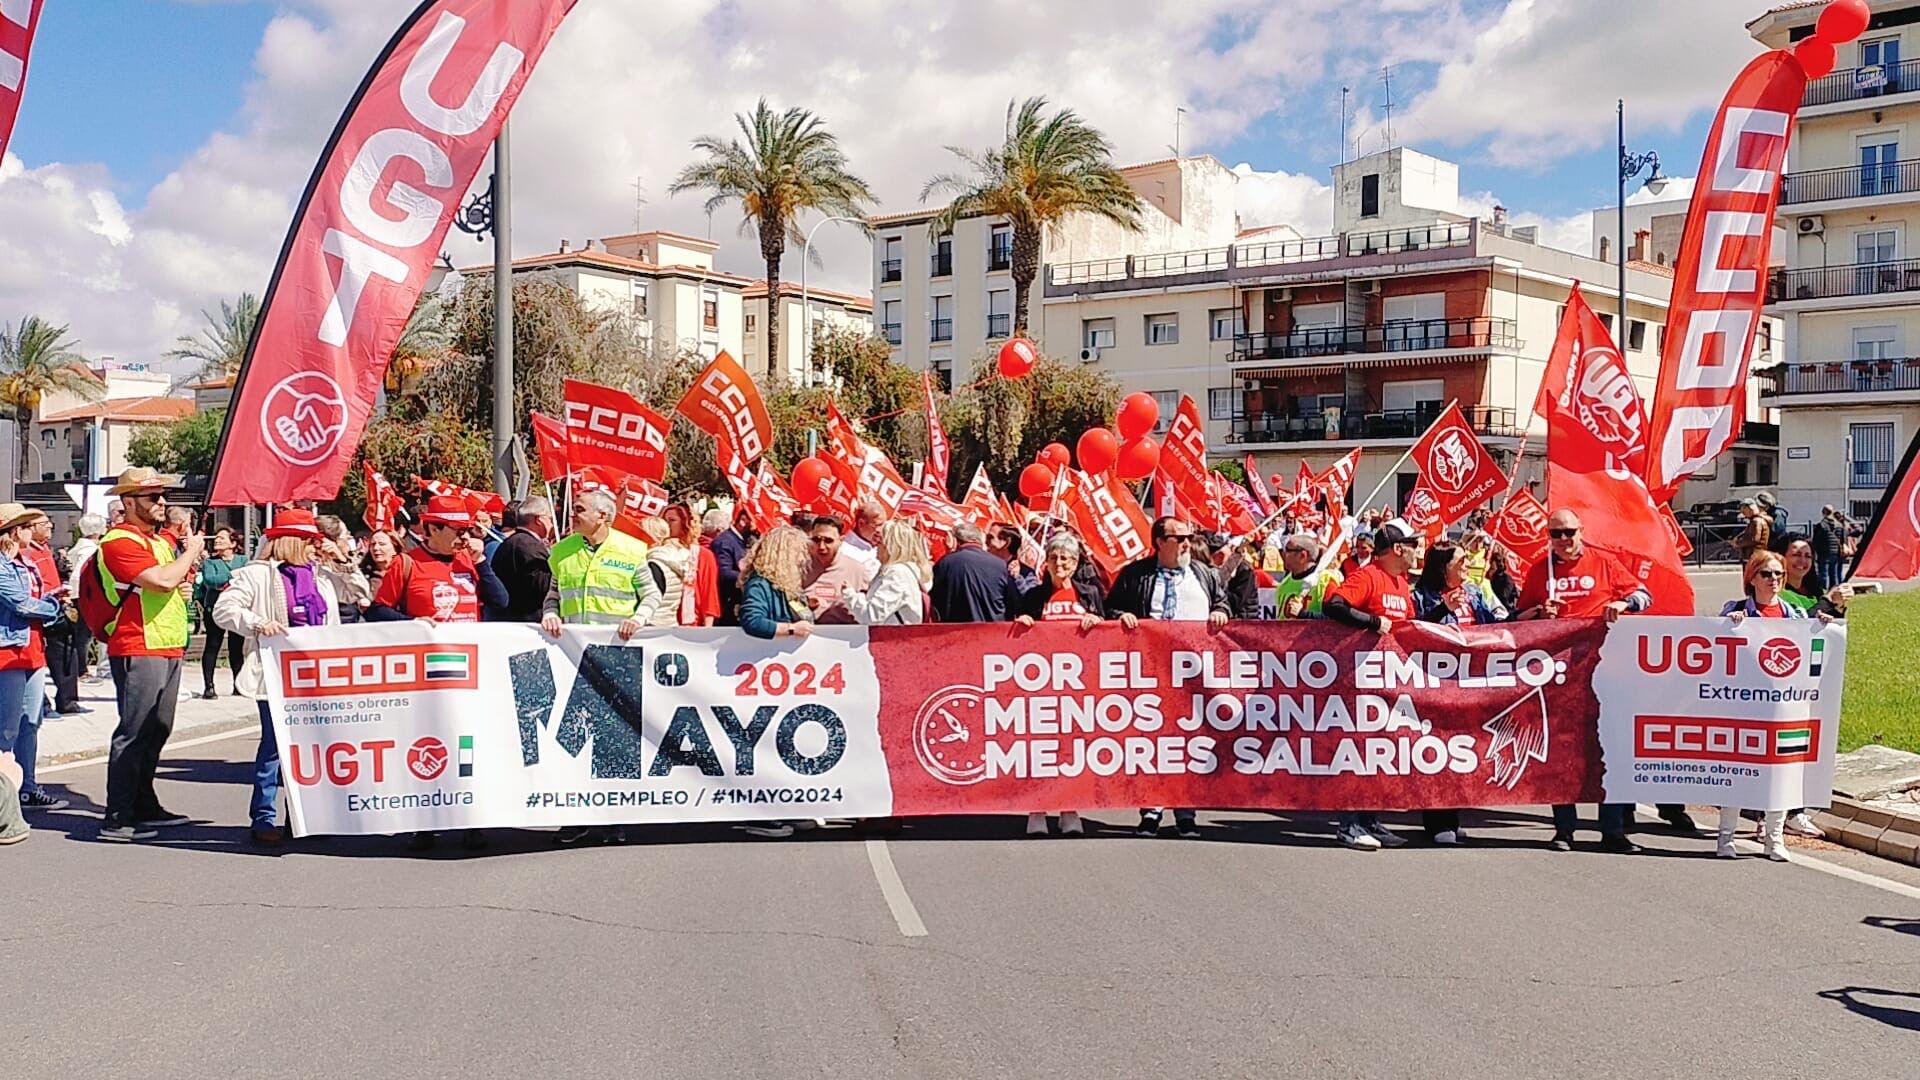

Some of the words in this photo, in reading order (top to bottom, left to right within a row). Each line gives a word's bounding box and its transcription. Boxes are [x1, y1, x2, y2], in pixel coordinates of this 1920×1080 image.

[318, 10, 525, 347] UGT
[1662, 107, 1788, 486] CCOO
[565, 401, 665, 453] CCOO
[702, 368, 763, 460] CCOO
[1448, 477, 1496, 514] www.ugt.es
[290, 653, 416, 689] CCOO
[983, 653, 1086, 692] POR
[1100, 652, 1158, 690] EL
[1172, 651, 1338, 689] PLENO
[1355, 650, 1567, 689] EMPLEO:
[1637, 635, 1748, 676] UGT
[735, 662, 846, 696] 2024
[1700, 683, 1819, 702] Extremadura
[284, 699, 354, 713] comisiones
[358, 697, 409, 709] obreras
[284, 715, 299, 726] de
[303, 712, 382, 725] extremadura
[985, 694, 1164, 736] MENOS
[1177, 694, 1432, 736] JORNADA,
[986, 736, 1218, 779] MEJORES
[1233, 735, 1478, 776] SALARIOS
[1643, 723, 1767, 756] CCOO
[289, 740, 395, 787] UGT
[1634, 762, 1706, 774] comisiones
[1710, 763, 1760, 778] obreras
[1634, 774, 1649, 784] de
[1652, 775, 1732, 788] extremadura
[348, 789, 474, 812] Extremadura
[526, 790, 689, 809] #PLENOEMPLEO
[711, 787, 844, 805] #1MAYO2024
